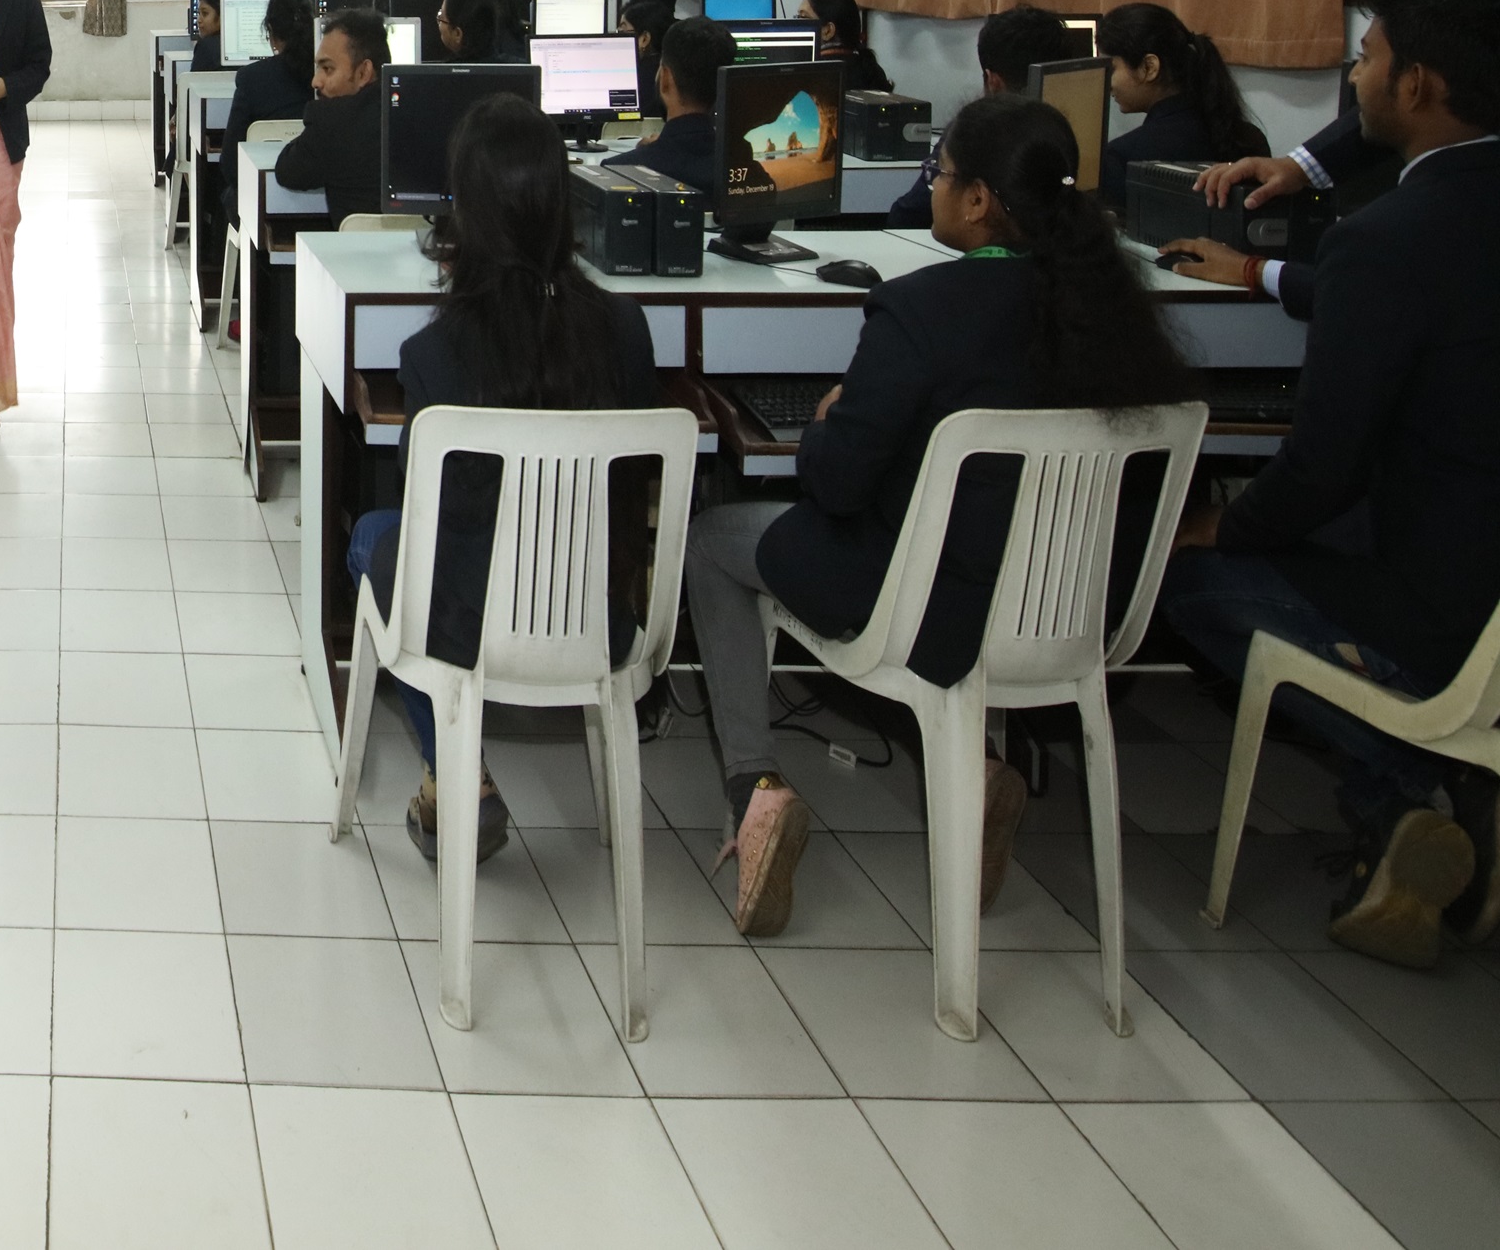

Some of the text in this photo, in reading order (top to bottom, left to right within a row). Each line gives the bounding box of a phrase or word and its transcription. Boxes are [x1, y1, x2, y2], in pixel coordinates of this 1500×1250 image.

[728, 167, 748, 183] 3:37
[746, 184, 769, 193] December
[769, 183, 774, 191] 19
